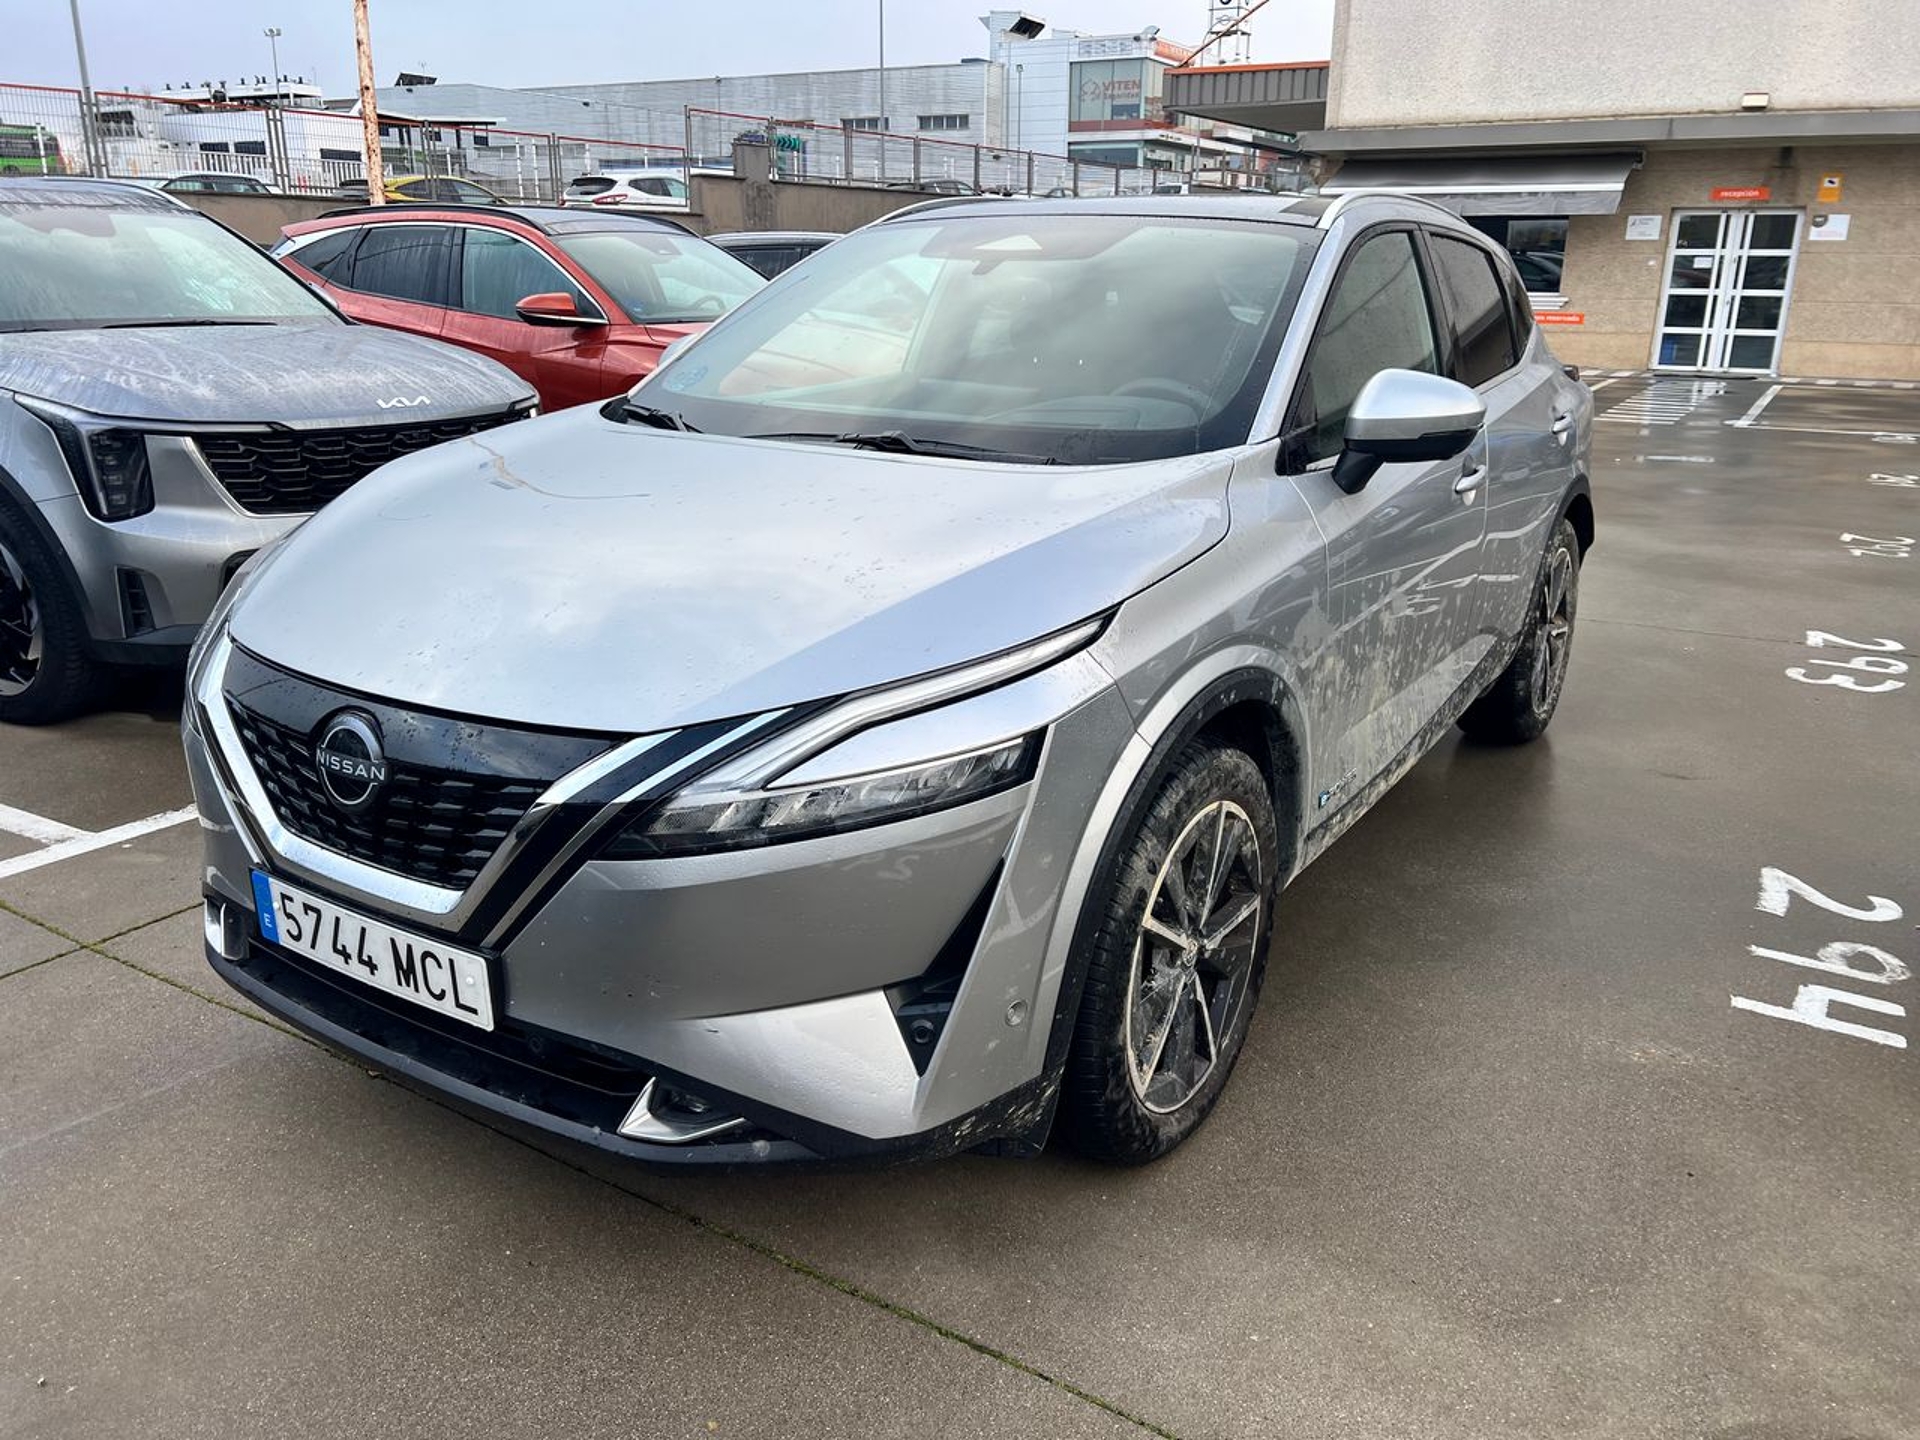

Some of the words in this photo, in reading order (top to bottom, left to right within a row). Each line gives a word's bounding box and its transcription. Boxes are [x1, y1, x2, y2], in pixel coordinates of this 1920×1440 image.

[376, 396, 431, 409] KIA
[1839, 532, 1916, 558] 292
[1784, 630, 1909, 692] 293
[316, 748, 385, 781] NISSAN
[280, 891, 379, 977] 5744
[389, 937, 479, 1016] MCL
[1730, 866, 1912, 1049] 294
